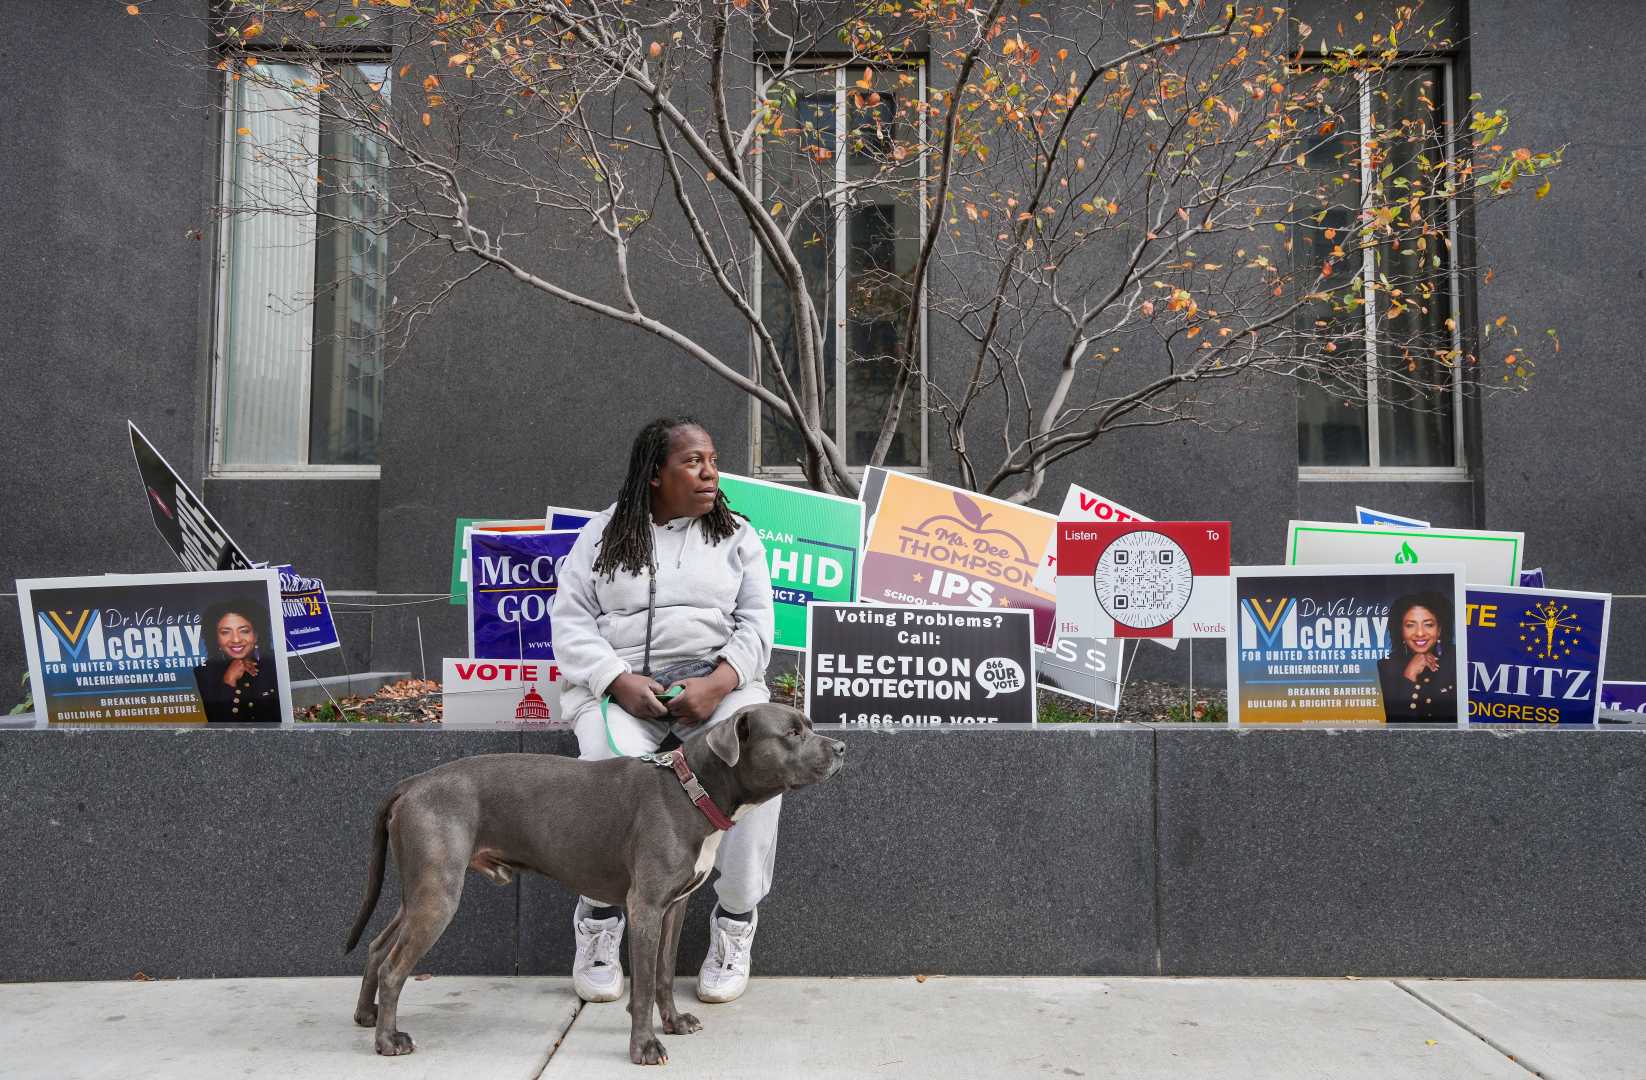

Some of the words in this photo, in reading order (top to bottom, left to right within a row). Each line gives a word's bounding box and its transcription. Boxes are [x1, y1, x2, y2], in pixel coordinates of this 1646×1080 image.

[1079, 491, 1142, 522] VOT
[758, 528, 794, 544] SAAN
[934, 526, 969, 548] Ms.
[973, 537, 1010, 559] Dee
[1064, 530, 1098, 541] Listen
[1206, 530, 1220, 541] To
[770, 548, 844, 588] HID
[928, 568, 996, 609] IPS
[797, 593, 806, 603] 2
[497, 594, 557, 623] GO
[834, 609, 897, 627] Voting
[903, 611, 1003, 629] Problems?
[1240, 598, 1389, 650] McCRAY
[38, 608, 202, 663] McCRAY
[1060, 622, 1080, 633] His
[1192, 622, 1226, 633] Words
[897, 630, 941, 645] Call:
[1241, 651, 1261, 661] FOR
[1265, 650, 1303, 661] UNITED
[1307, 649, 1346, 660] STATES
[1350, 649, 1391, 660] SENATE
[45, 663, 67, 675] FOR
[72, 661, 113, 673] UNITED
[118, 659, 160, 671] STATES
[165, 656, 207, 669] SENATE
[454, 663, 538, 682] VOTE
[817, 653, 971, 677] ELECTION
[986, 660, 1003, 670] 866
[1267, 664, 1361, 675] VALERIEMCCRAY.ORG
[75, 672, 177, 687] VALERIEMCCRAY.ORG
[983, 667, 1017, 682] OUR
[1467, 661, 1591, 701] MITZ
[816, 677, 971, 701] PROTECTION
[992, 679, 1020, 690] VOTE
[1287, 688, 1331, 696] BREAKING
[1333, 687, 1380, 696] BARRIERS.
[100, 694, 147, 707] BREAKING
[149, 693, 199, 705] BARRIERS.
[1247, 699, 1288, 709] BUILDING
[1290, 699, 1297, 708] A
[1299, 698, 1342, 708] BRIGHTER
[1344, 698, 1380, 707] FUTURE.
[57, 708, 102, 721] BUILDING
[105, 709, 112, 719] A
[114, 706, 160, 718] BRIGHTER
[163, 705, 200, 716] FUTURE.
